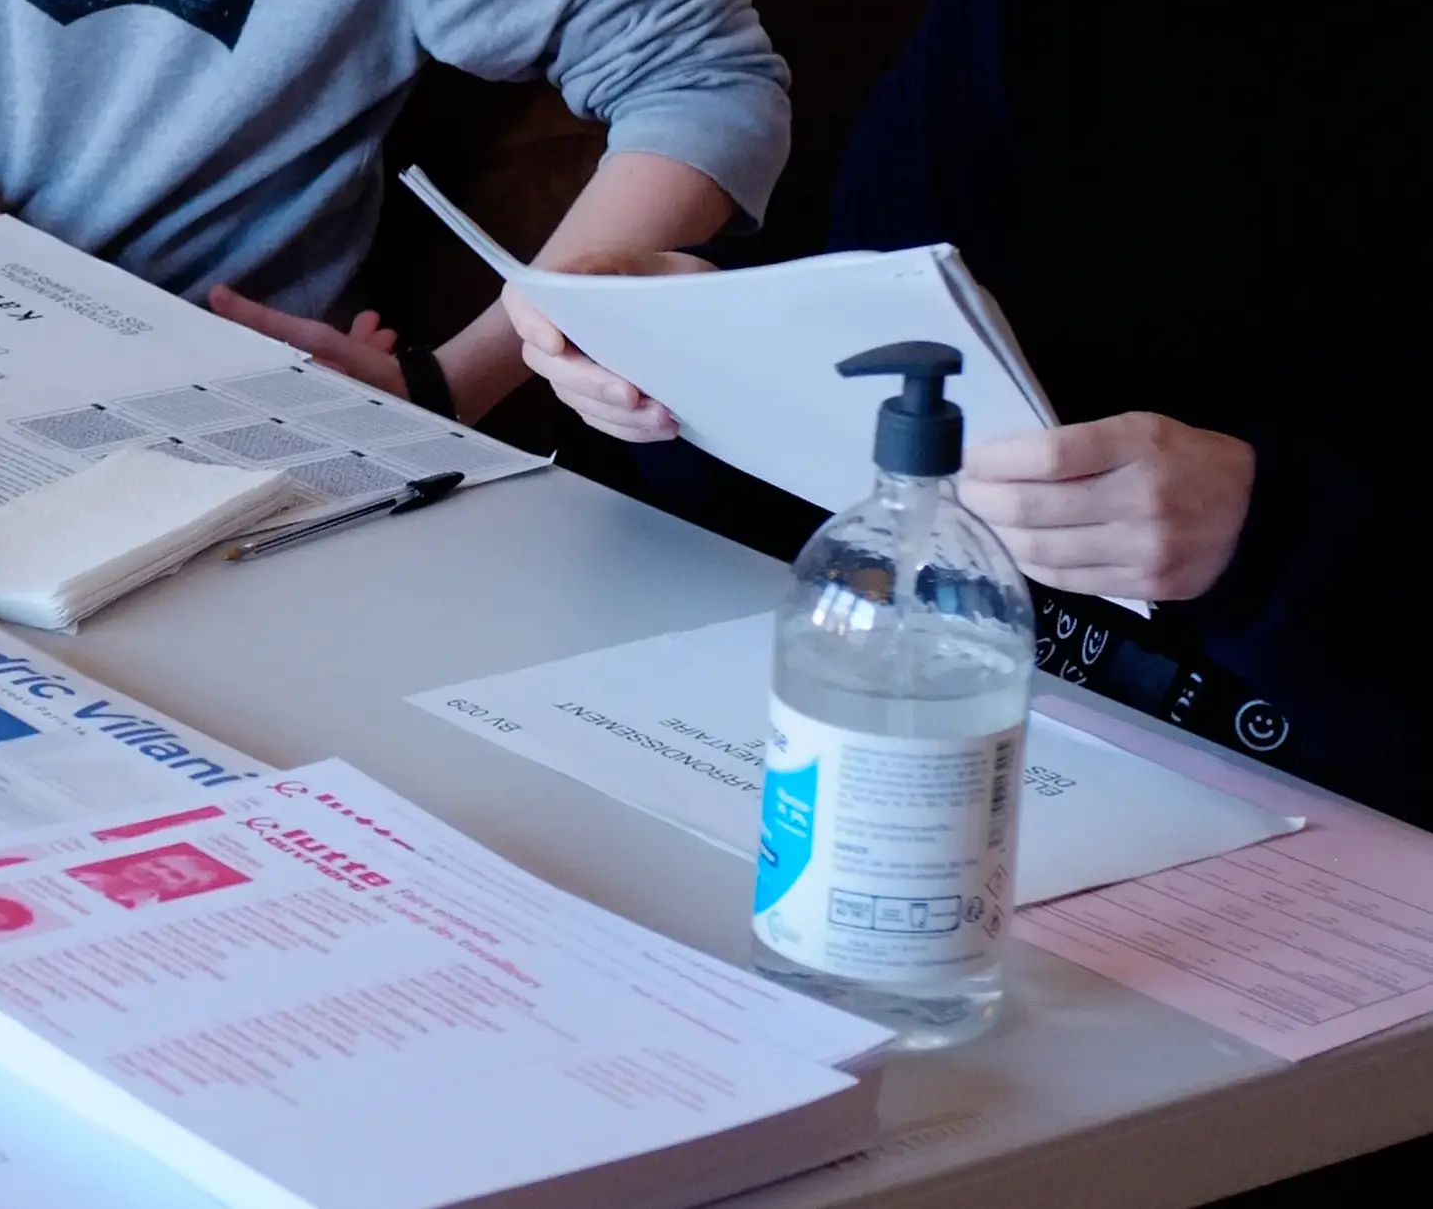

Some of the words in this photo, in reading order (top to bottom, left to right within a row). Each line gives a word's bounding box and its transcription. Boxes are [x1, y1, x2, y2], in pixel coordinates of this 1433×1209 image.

[5, 309, 44, 320] K
[446, 698, 489, 718] 029
[488, 716, 522, 733] BV
[75, 698, 260, 788] Villani
[554, 701, 761, 792] ARRONDISSEMENT
